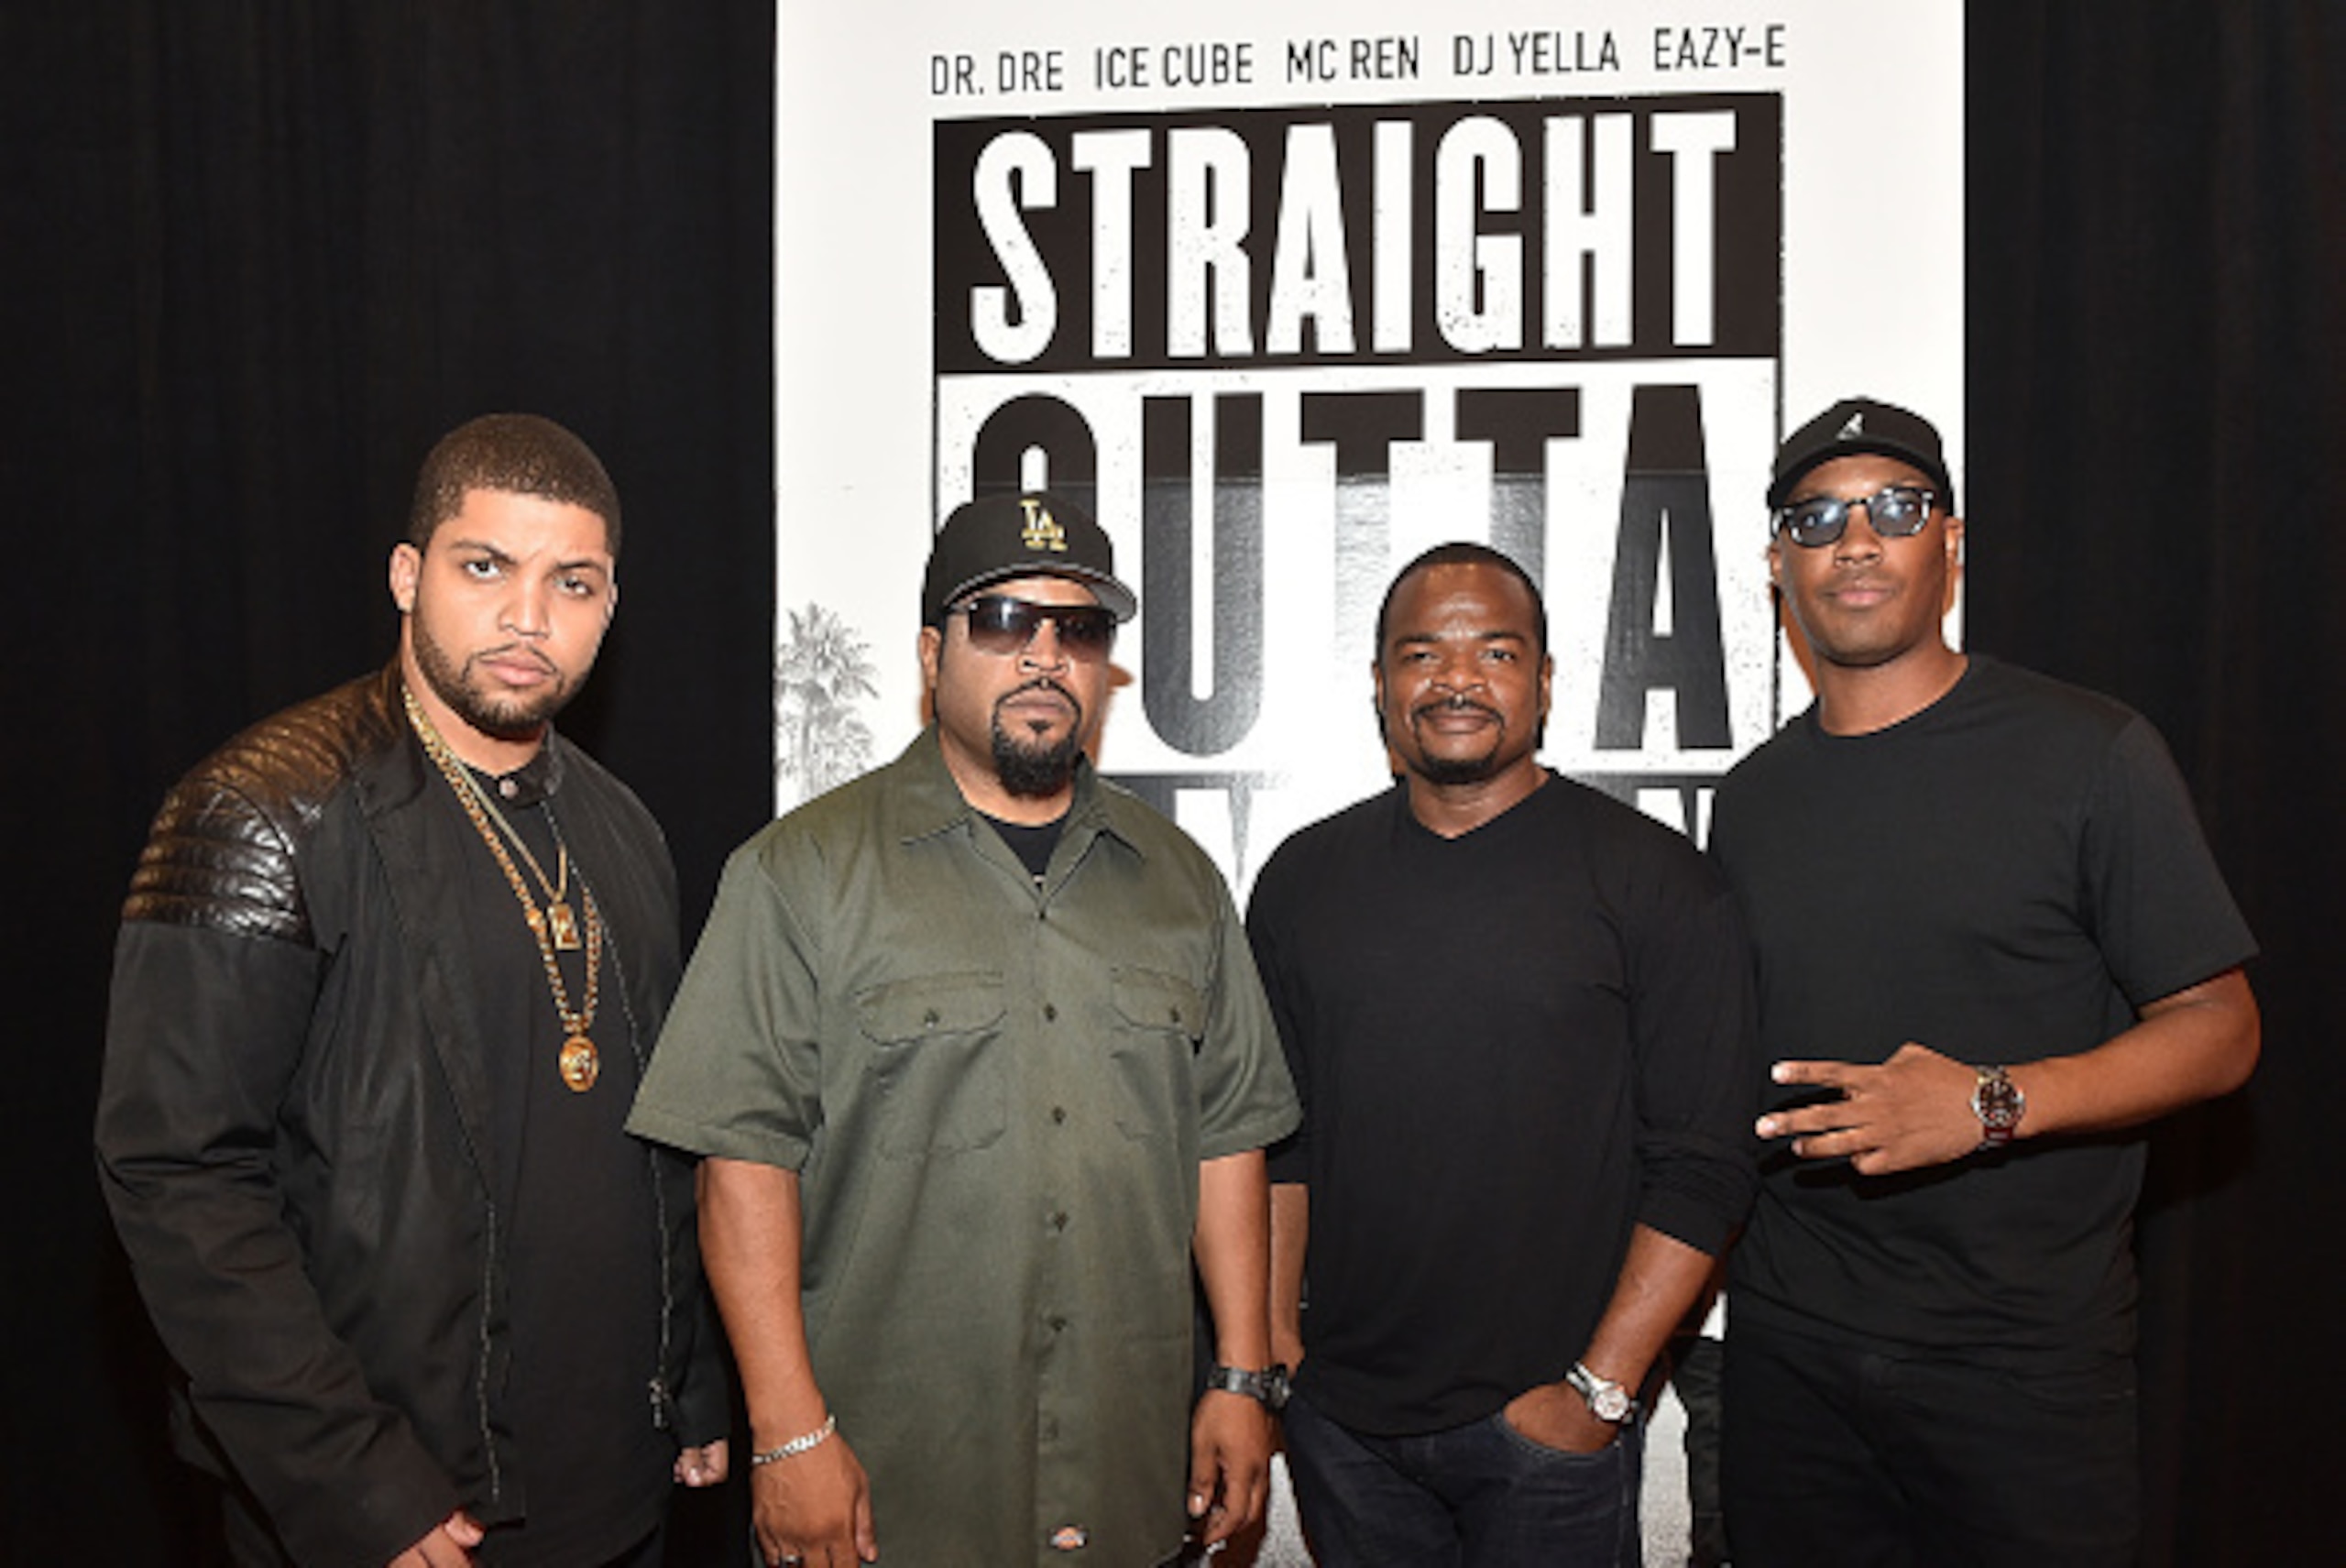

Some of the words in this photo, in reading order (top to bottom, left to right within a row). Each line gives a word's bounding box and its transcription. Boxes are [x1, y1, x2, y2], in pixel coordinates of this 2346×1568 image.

[932, 55, 985, 95] DR.
[999, 51, 1063, 93] DRE
[1096, 47, 1149, 89] ICE
[1163, 43, 1252, 87] CUBE
[1288, 39, 1336, 83] MC
[1351, 36, 1419, 80] REN
[1453, 34, 1494, 75] DJ
[1508, 31, 1619, 75] YELLA
[1653, 25, 1785, 71] EAZY-E
[970, 111, 1737, 364] STRAIGHT
[1018, 499, 1069, 552] LA
